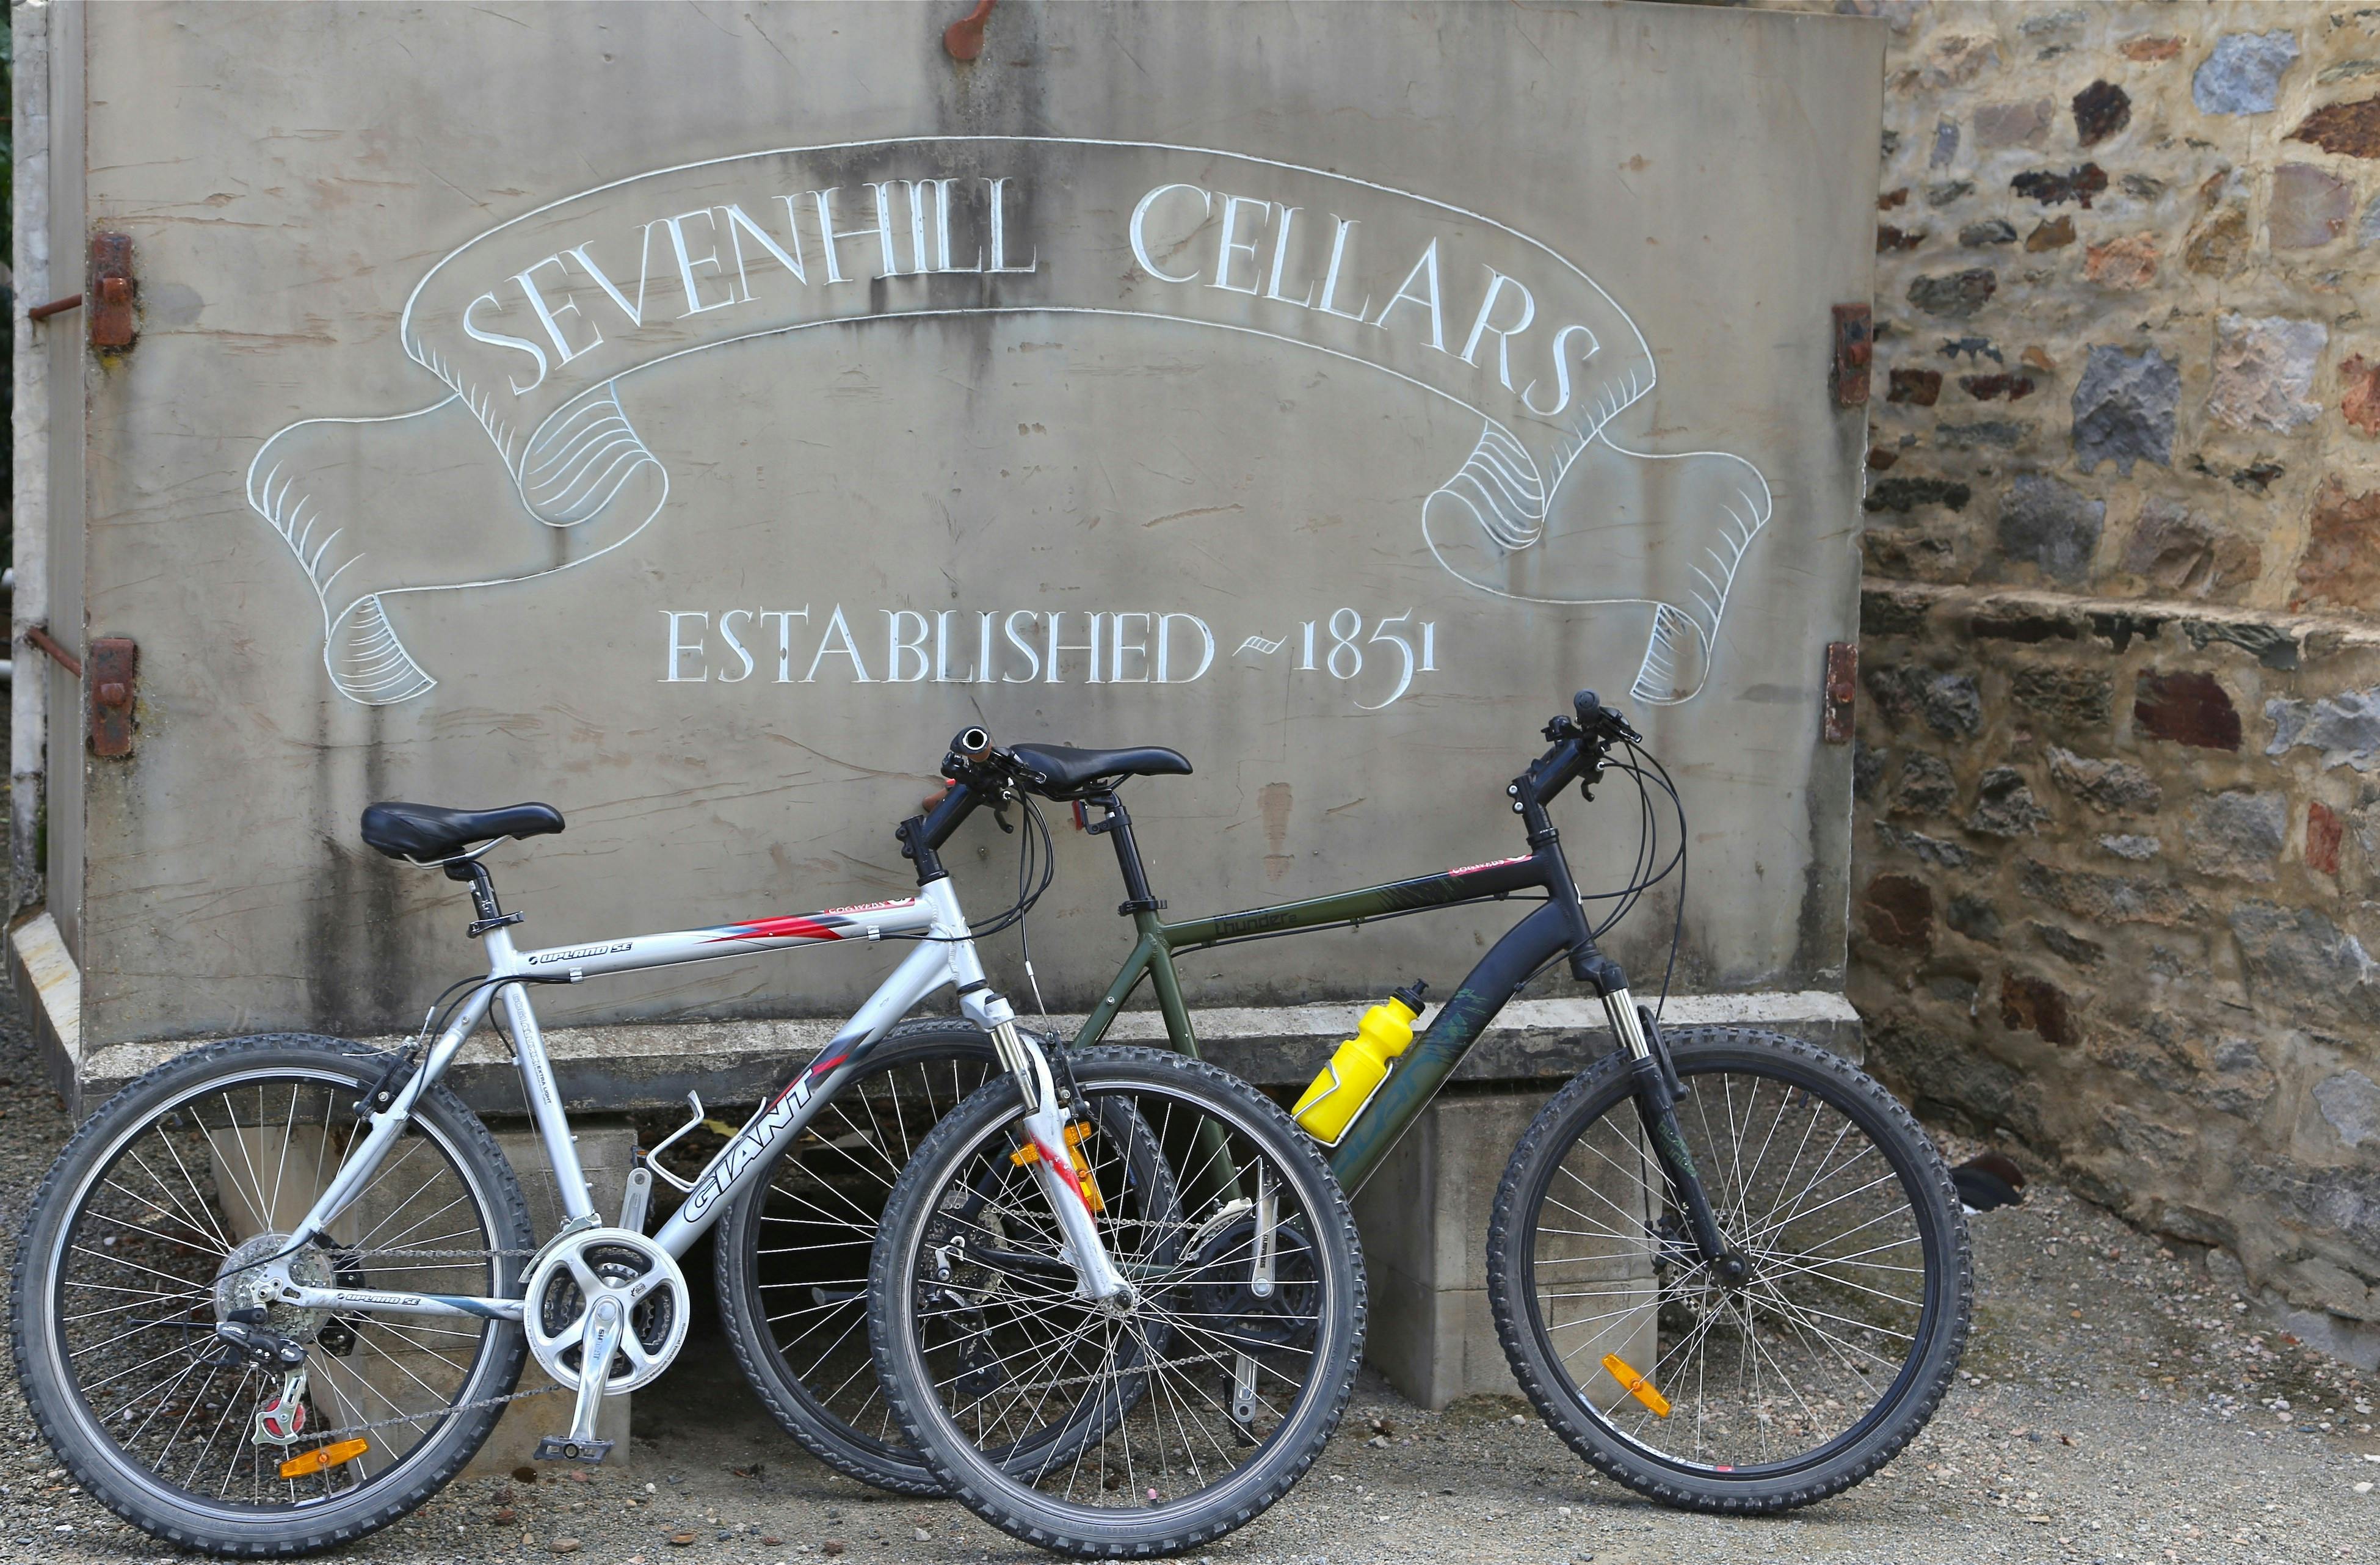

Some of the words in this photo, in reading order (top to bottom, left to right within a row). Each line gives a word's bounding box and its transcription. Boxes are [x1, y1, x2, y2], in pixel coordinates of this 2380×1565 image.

[463, 176, 1036, 396] SEVENHILL
[1129, 184, 1600, 416] CELLARS
[657, 603, 1215, 684] ESTABLISHED
[1294, 608, 1440, 710] 1851
[540, 946, 608, 963] UPLAND
[611, 942, 633, 953] SE
[537, 1066, 546, 1086] EXTRA
[543, 1086, 552, 1104] LIGHT
[683, 1068, 813, 1222] GIANT
[346, 1294, 401, 1304] UPLAND
